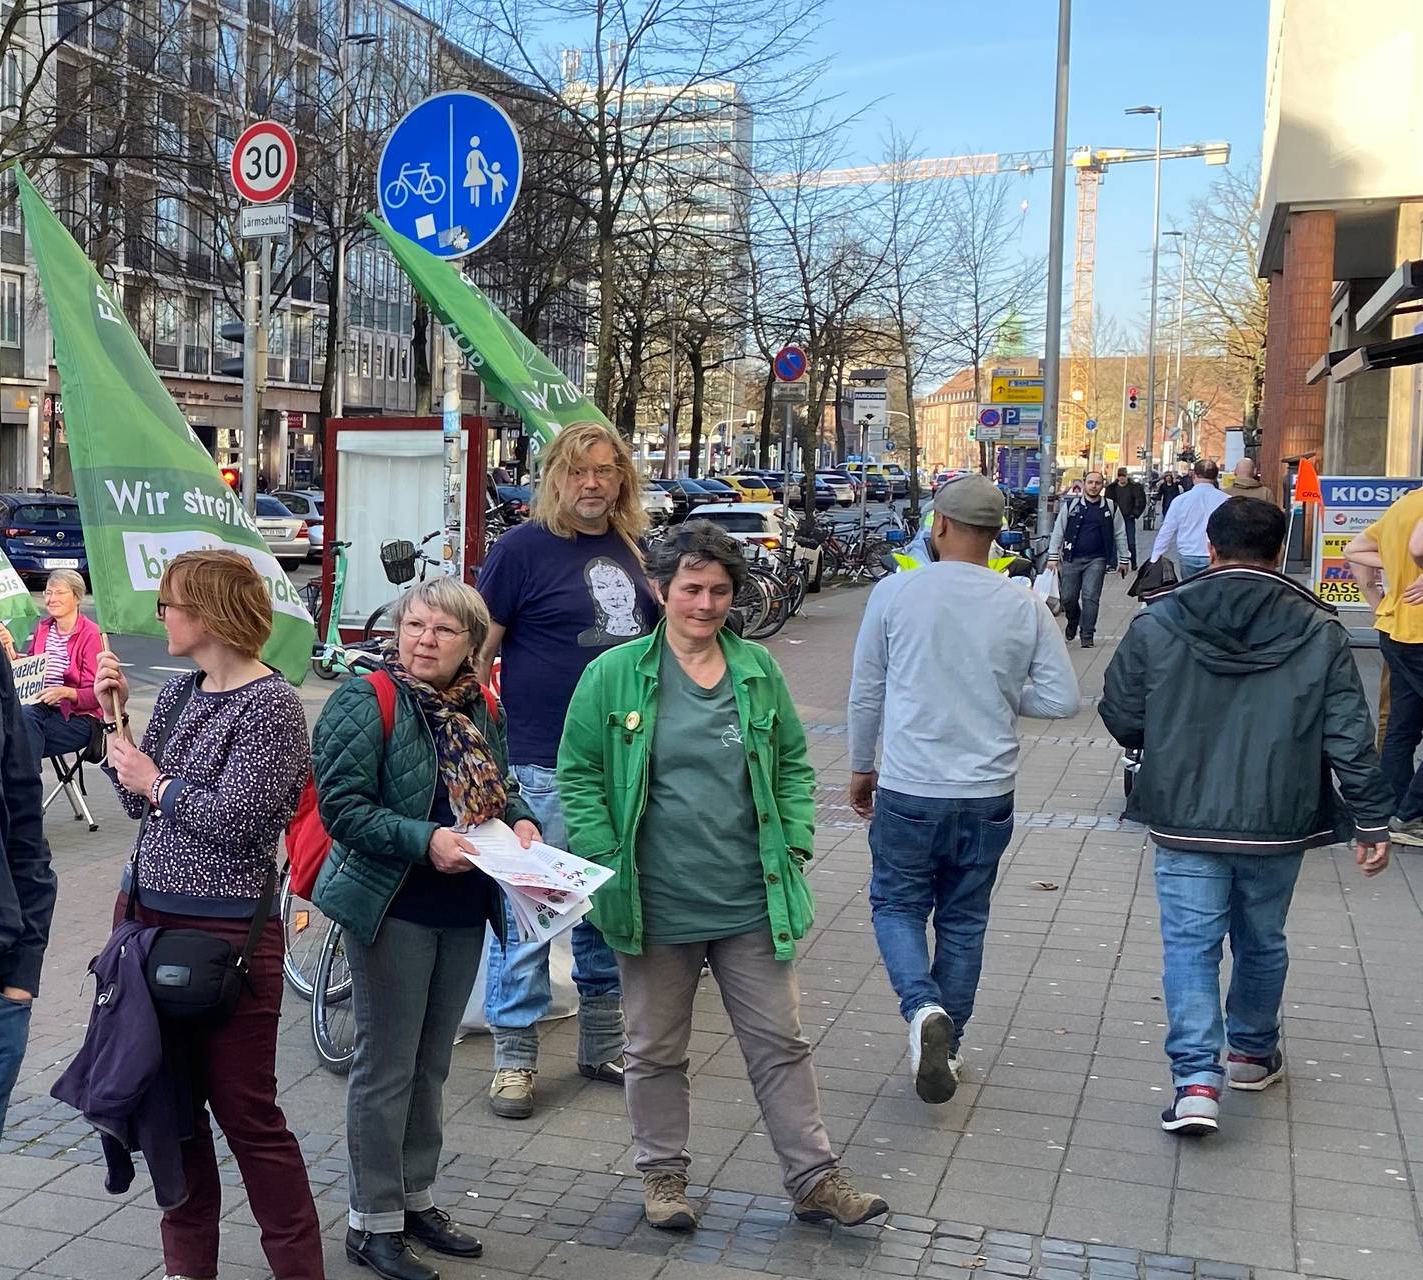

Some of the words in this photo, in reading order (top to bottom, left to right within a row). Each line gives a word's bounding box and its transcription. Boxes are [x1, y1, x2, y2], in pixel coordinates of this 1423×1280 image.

[245, 143, 281, 180] 30
[243, 214, 286, 230] Lärmschutz
[1006, 409, 1017, 424] P
[1331, 486, 1409, 502] KIOSK
[104, 479, 169, 516] Wir
[183, 486, 265, 541] streike
[1319, 582, 1360, 594] PASS
[1319, 593, 1360, 603] FOTOS
